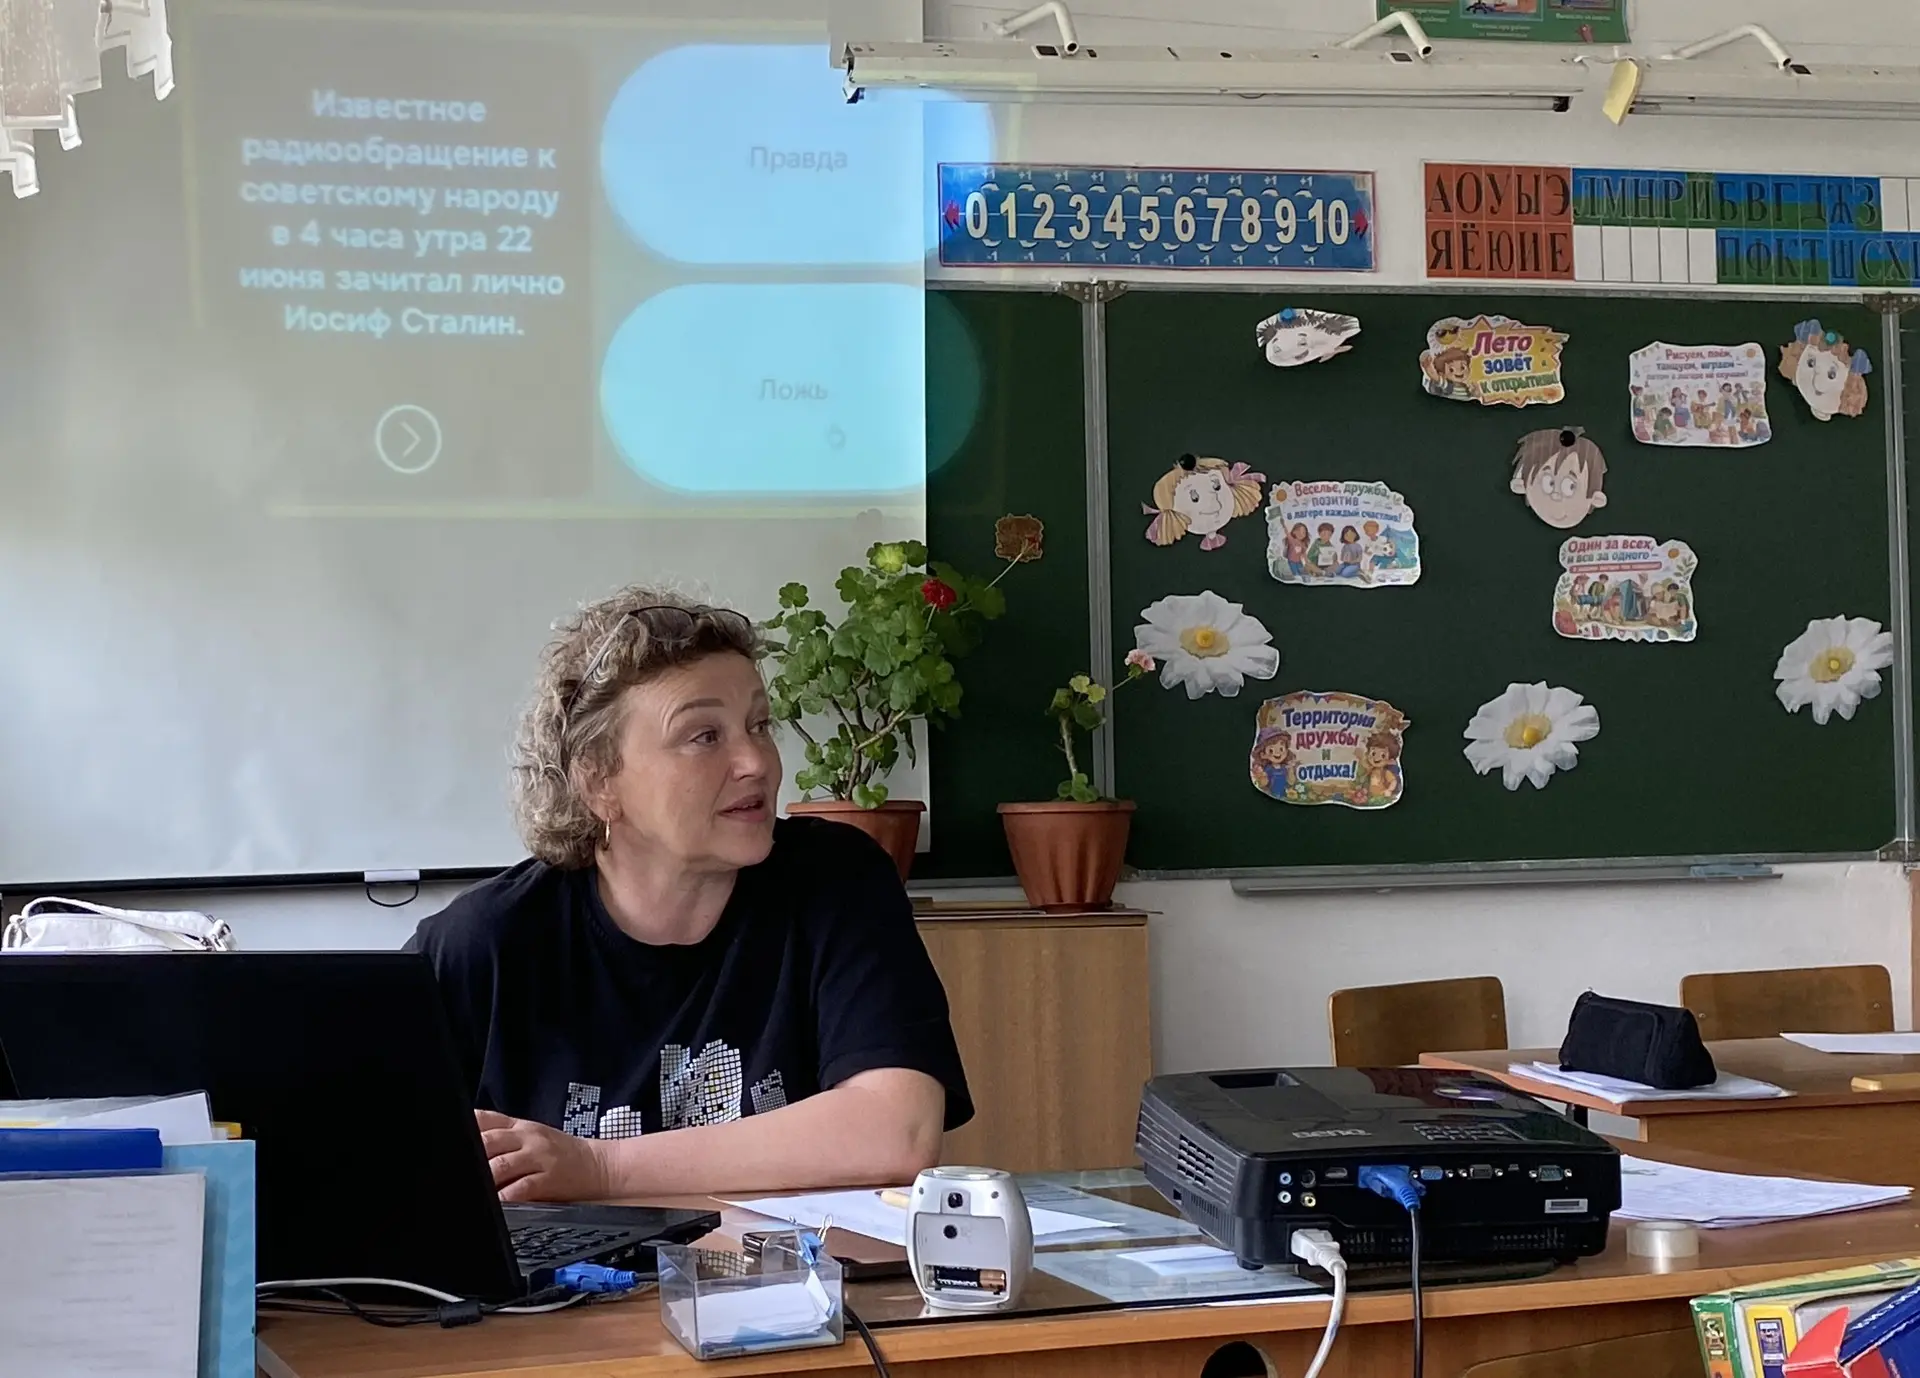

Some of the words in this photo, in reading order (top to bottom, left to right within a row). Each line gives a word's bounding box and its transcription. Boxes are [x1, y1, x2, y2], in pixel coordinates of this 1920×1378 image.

[312, 89, 486, 122] Известное
[241, 136, 528, 170] радиообращение
[538, 148, 556, 169] к
[750, 147, 848, 173] Правда
[982, 171, 995, 179] +1
[1019, 171, 1031, 180] +1
[1055, 171, 1068, 181] +1
[1091, 172, 1104, 182] +1
[1125, 172, 1139, 182] +1
[1160, 173, 1173, 183] +1
[1196, 174, 1209, 184] +1
[1229, 175, 1242, 185] +1
[1264, 175, 1277, 185] +1
[1300, 176, 1312, 186] +1
[240, 180, 435, 215] советскому
[445, 188, 559, 218] народу
[965, 191, 987, 239] 0
[1000, 192, 1017, 239] 1
[1033, 193, 1055, 239] 2
[1069, 194, 1091, 240] 3
[1103, 194, 1126, 241] 4
[1139, 196, 1160, 242] 5
[1174, 196, 1196, 243] 6
[1206, 197, 1228, 242] 7
[1240, 198, 1262, 243] 8
[1274, 198, 1296, 244] 9
[1308, 199, 1349, 245] 10
[271, 225, 290, 245] в
[299, 220, 320, 246] 4
[331, 227, 403, 249] часа
[413, 229, 486, 257] утра
[496, 226, 532, 252] 22
[240, 268, 325, 289] июня
[336, 271, 461, 292] зачитал
[472, 274, 564, 295] лично
[285, 305, 391, 338] Иосиф
[401, 307, 525, 336] Сталин.
[1472, 332, 1532, 356] Лето
[1484, 353, 1532, 374] зовёт
[758, 379, 828, 401] Ложь
[1295, 484, 1342, 497] Веселье,
[1344, 483, 1390, 498] дружба,
[1312, 496, 1359, 507] позитив
[1568, 539, 1602, 553] Один
[1606, 540, 1619, 549] за
[1622, 539, 1655, 550] всех,
[1597, 552, 1609, 561] за
[1612, 552, 1649, 562] одного
[1282, 708, 1376, 729] Территория
[1296, 729, 1359, 749] дружбы
[1322, 750, 1331, 760] и
[1298, 761, 1357, 780] отдыха!
